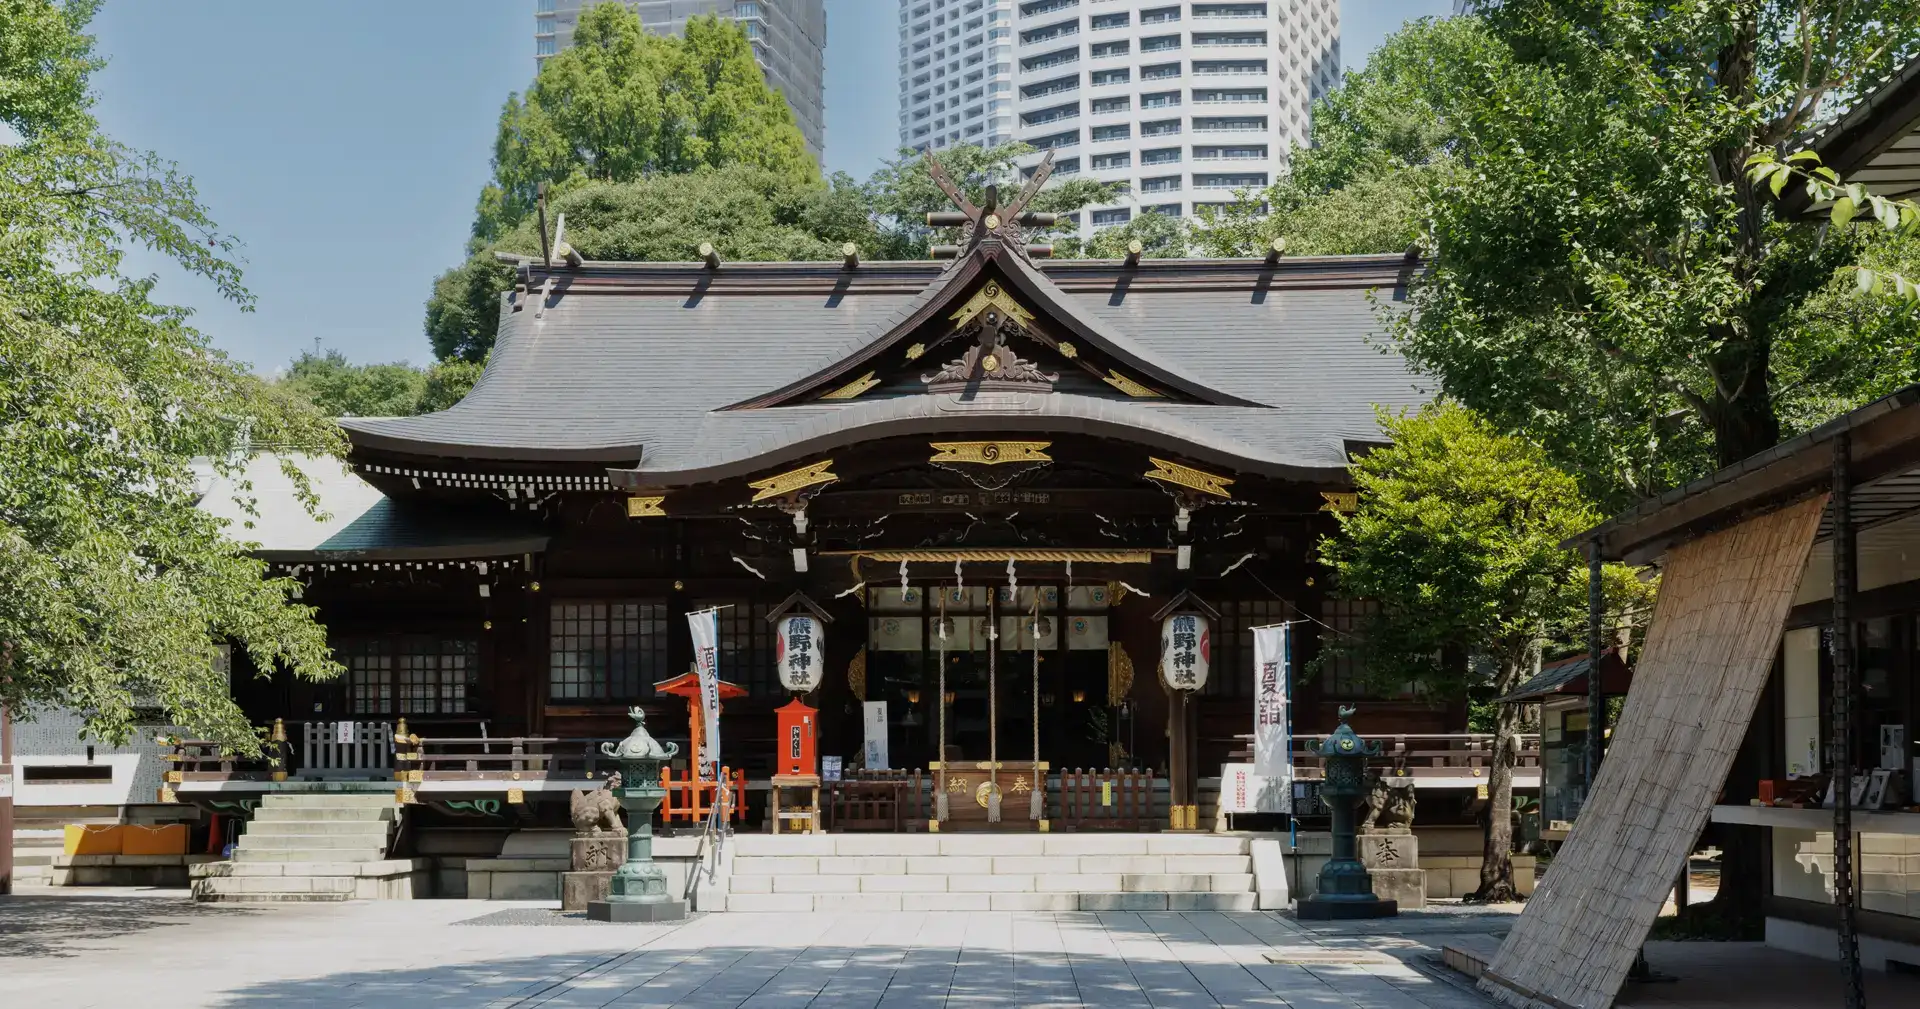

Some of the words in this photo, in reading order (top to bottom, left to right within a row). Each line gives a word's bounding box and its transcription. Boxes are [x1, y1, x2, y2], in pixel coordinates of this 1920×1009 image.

[788, 618, 811, 685] 熊野神社
[1173, 615, 1196, 684] 熊野神社
[1259, 662, 1280, 725] 夏詣
[947, 776, 968, 794] 納
[1011, 775, 1030, 794] 奉
[1376, 838, 1400, 866] 奉
